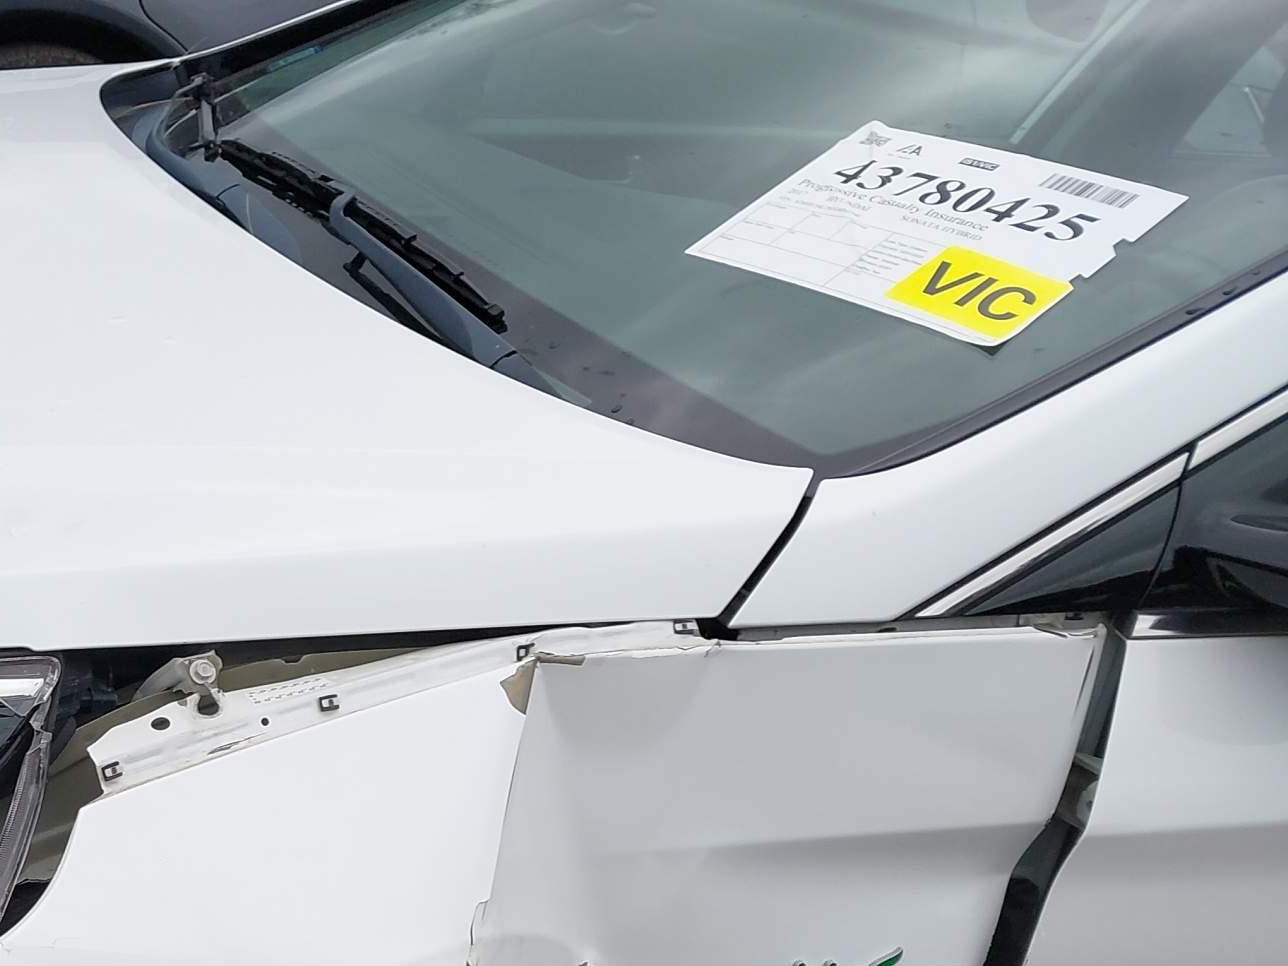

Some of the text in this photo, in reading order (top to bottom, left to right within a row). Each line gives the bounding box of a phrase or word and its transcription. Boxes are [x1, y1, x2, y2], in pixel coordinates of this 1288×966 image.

[834, 159, 1102, 242] 43780425
[869, 194, 920, 213] Casualty
[924, 208, 990, 232] Insurance
[921, 260, 1037, 321] VIC
